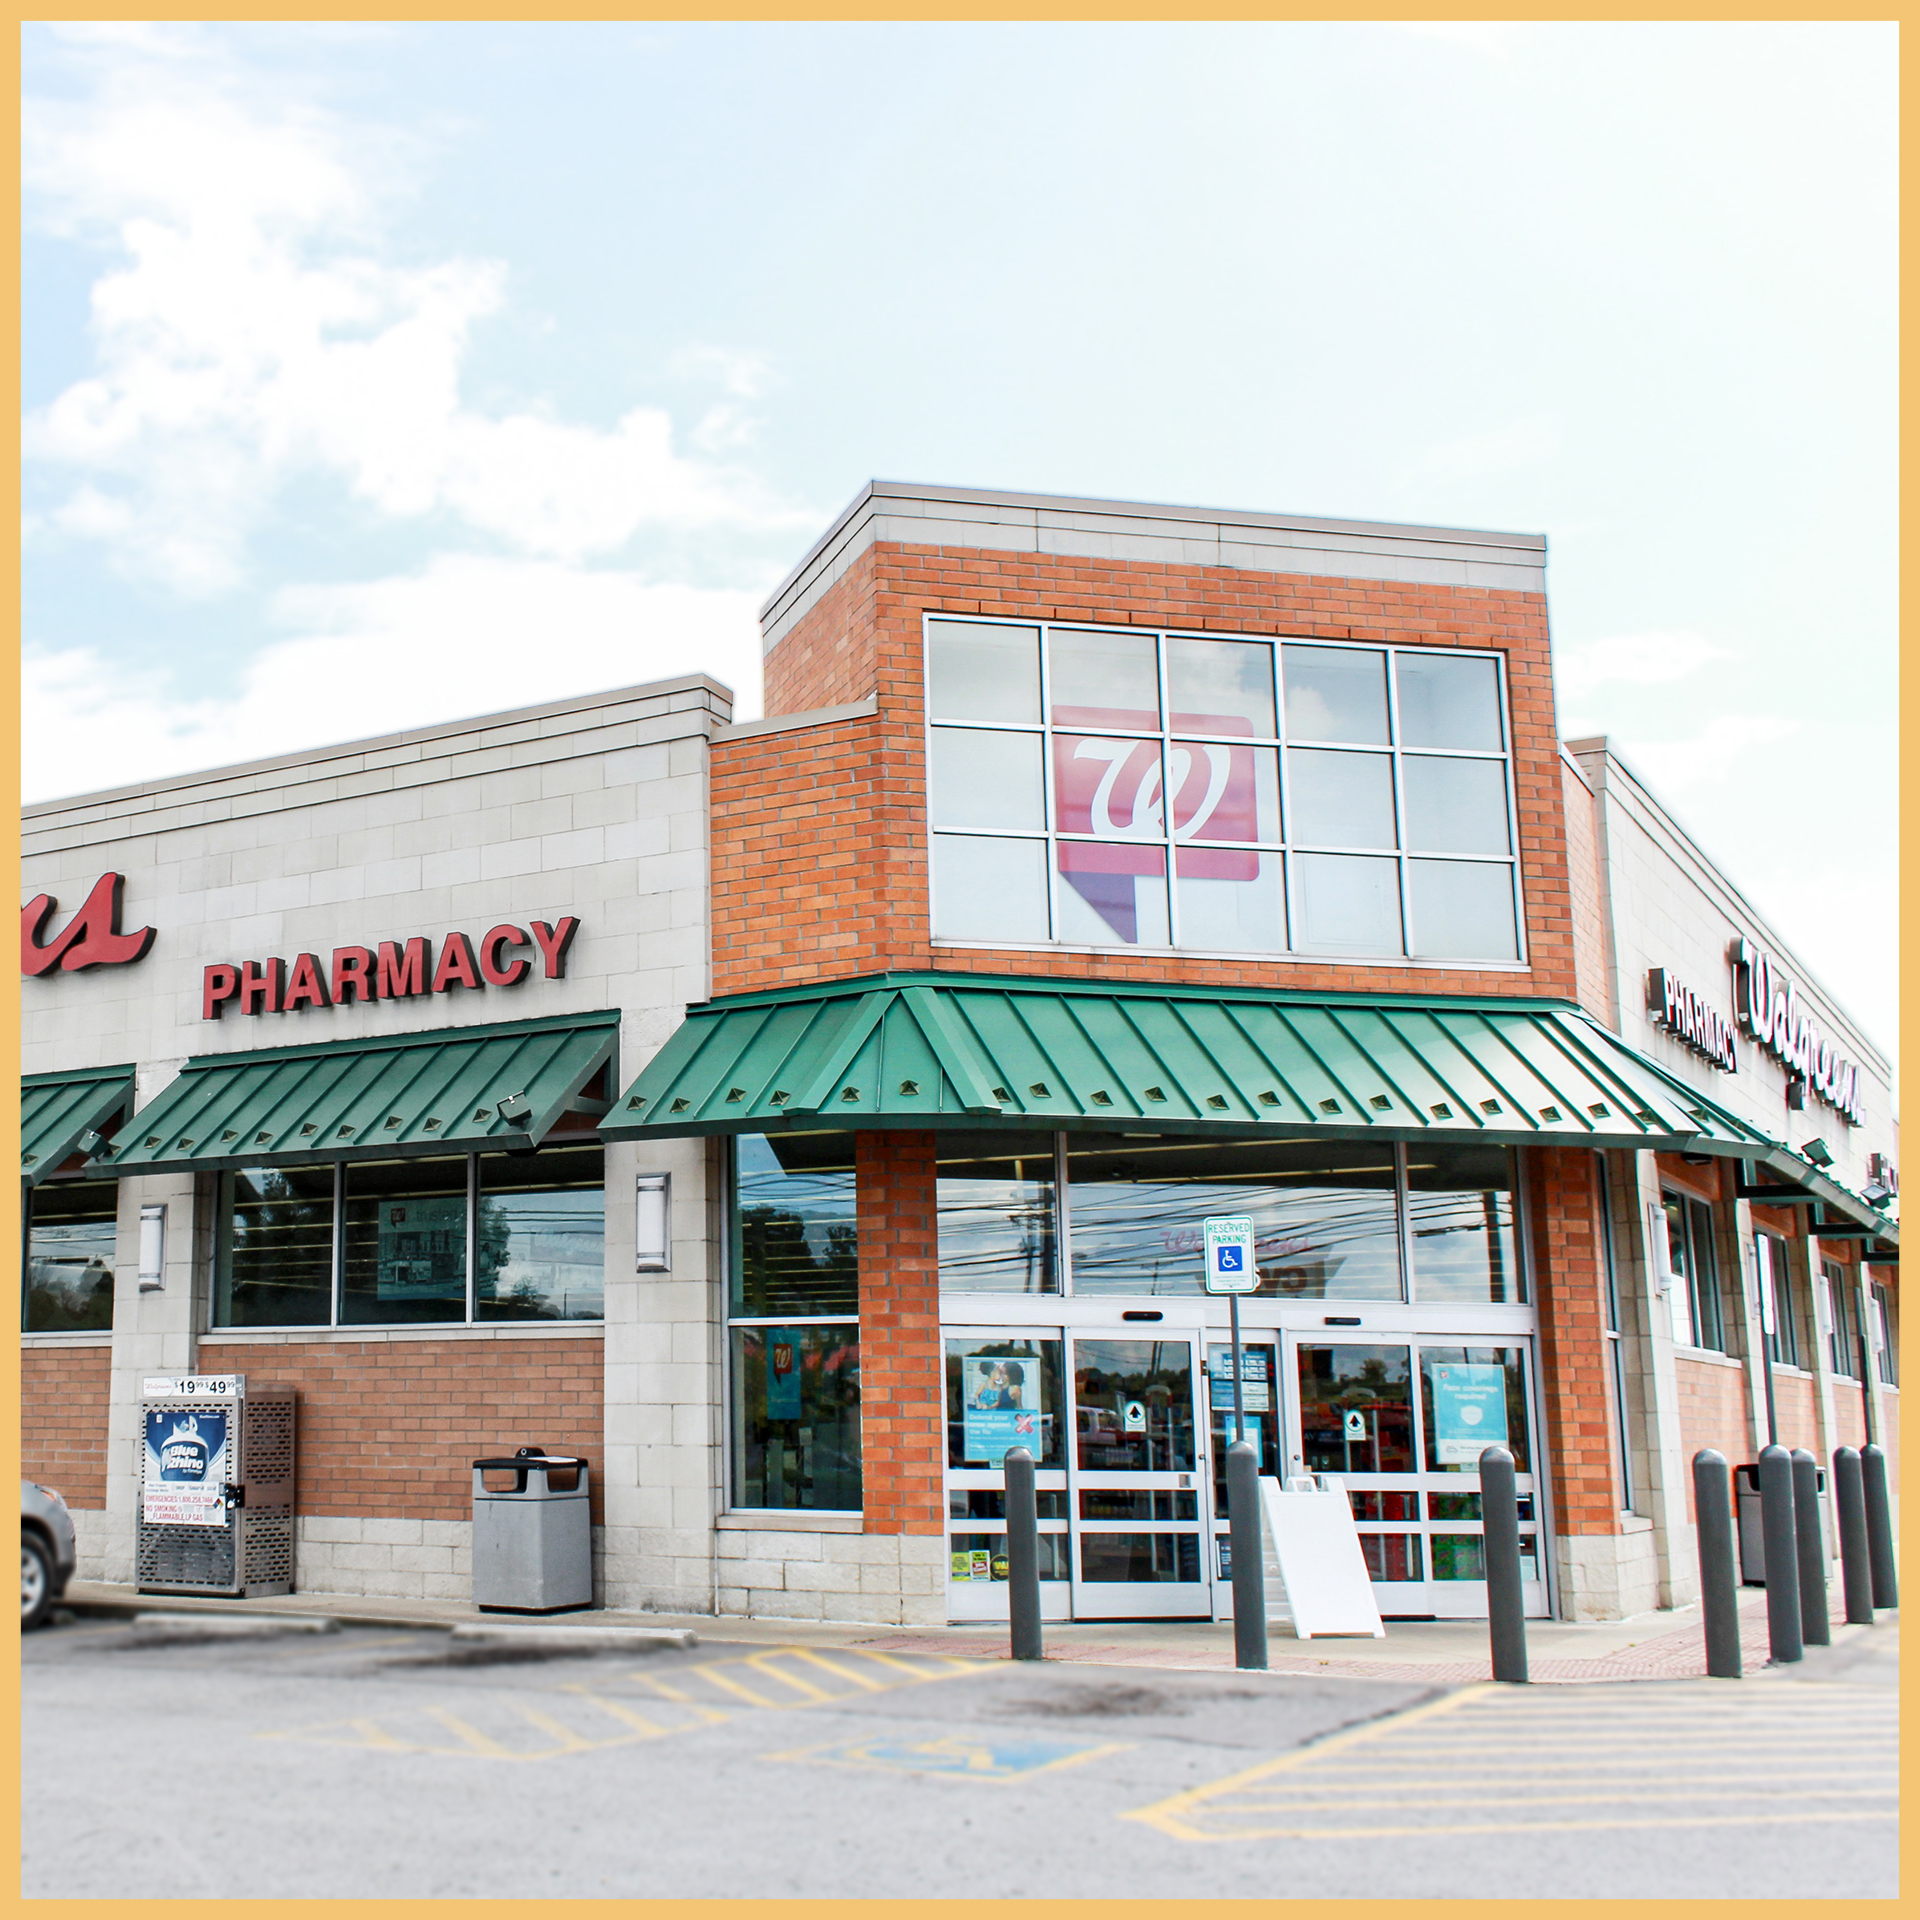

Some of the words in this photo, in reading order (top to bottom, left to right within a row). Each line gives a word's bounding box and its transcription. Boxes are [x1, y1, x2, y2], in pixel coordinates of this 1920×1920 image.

[202, 916, 581, 1020] PHARMACY
[1653, 967, 1738, 1073] PHARMACY
[1734, 936, 1866, 1126] Walgreens
[1208, 1223, 1250, 1233] RESERVED
[1213, 1234, 1246, 1244] PARKING
[171, 1444, 198, 1457] Blue
[153, 1513, 184, 1521] FLAMMABLE
[193, 1513, 203, 1521] GAS
